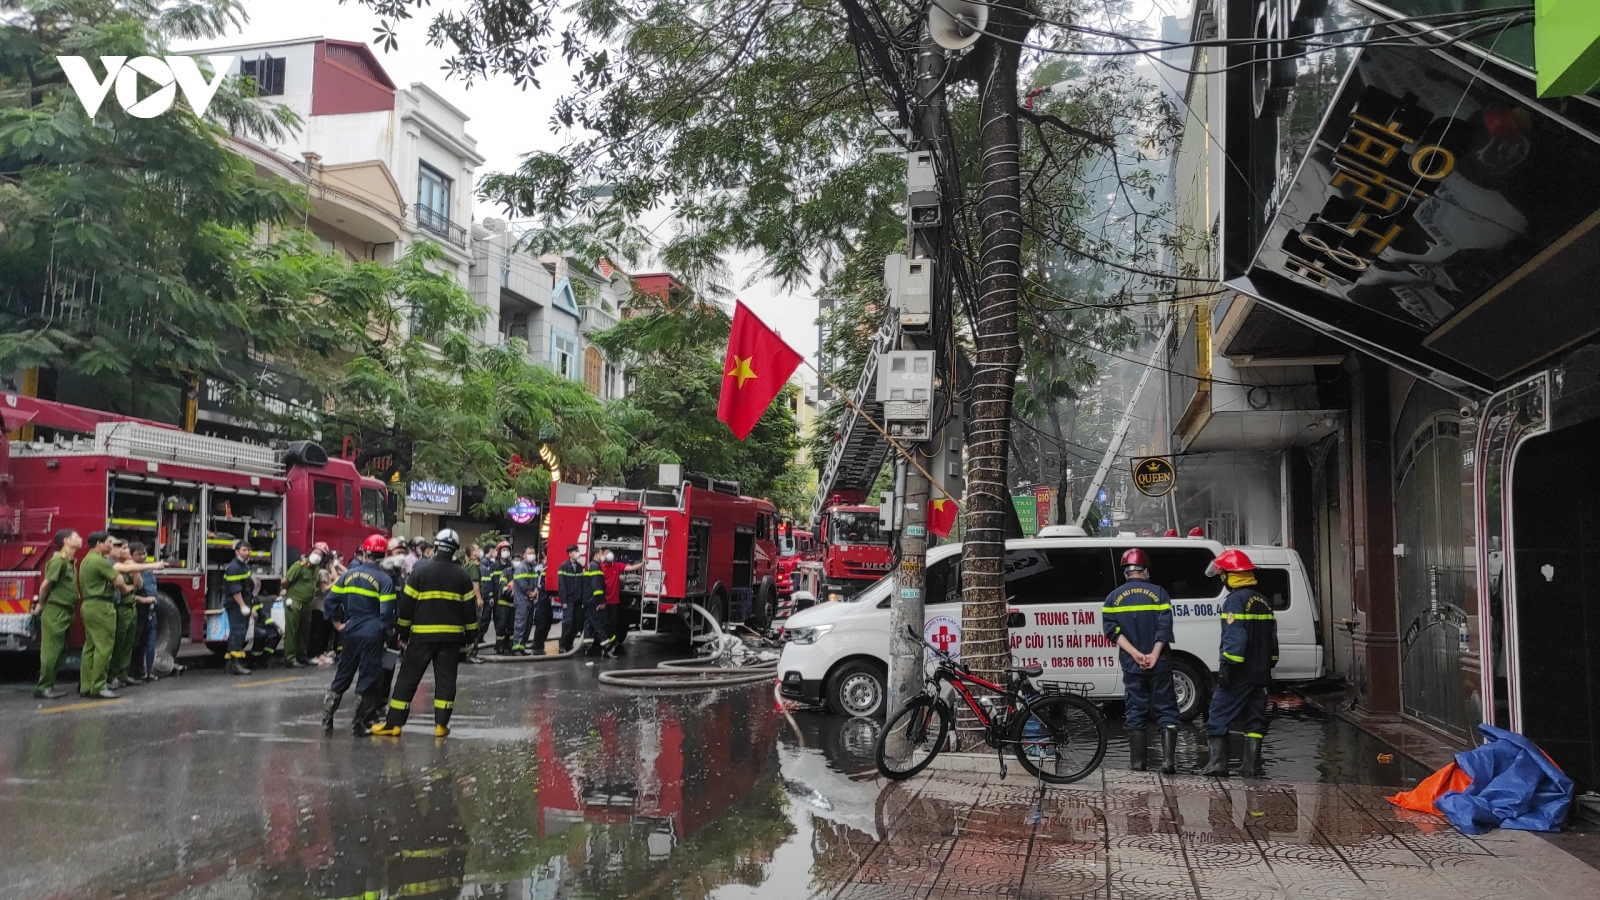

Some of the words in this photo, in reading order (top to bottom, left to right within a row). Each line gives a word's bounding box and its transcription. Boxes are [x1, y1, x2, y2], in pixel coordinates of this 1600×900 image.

[1463, 450, 1474, 466] 140
[1138, 472, 1170, 485] QUEEN
[862, 562, 892, 570] IVECO
[1171, 603, 1223, 617] 15A-008.4
[1034, 611, 1069, 626] TRUNG
[1072, 609, 1095, 625] TÂM
[935, 634, 952, 642] 115
[1010, 631, 1022, 649] ẤP
[1025, 632, 1044, 649] CỨU
[1047, 635, 1064, 649] 115
[1066, 630, 1082, 648] HẢI
[1021, 657, 1038, 667] 115
[1051, 657, 1074, 668] 0836
[1076, 656, 1094, 667] 680
[1097, 656, 1114, 667] 115
